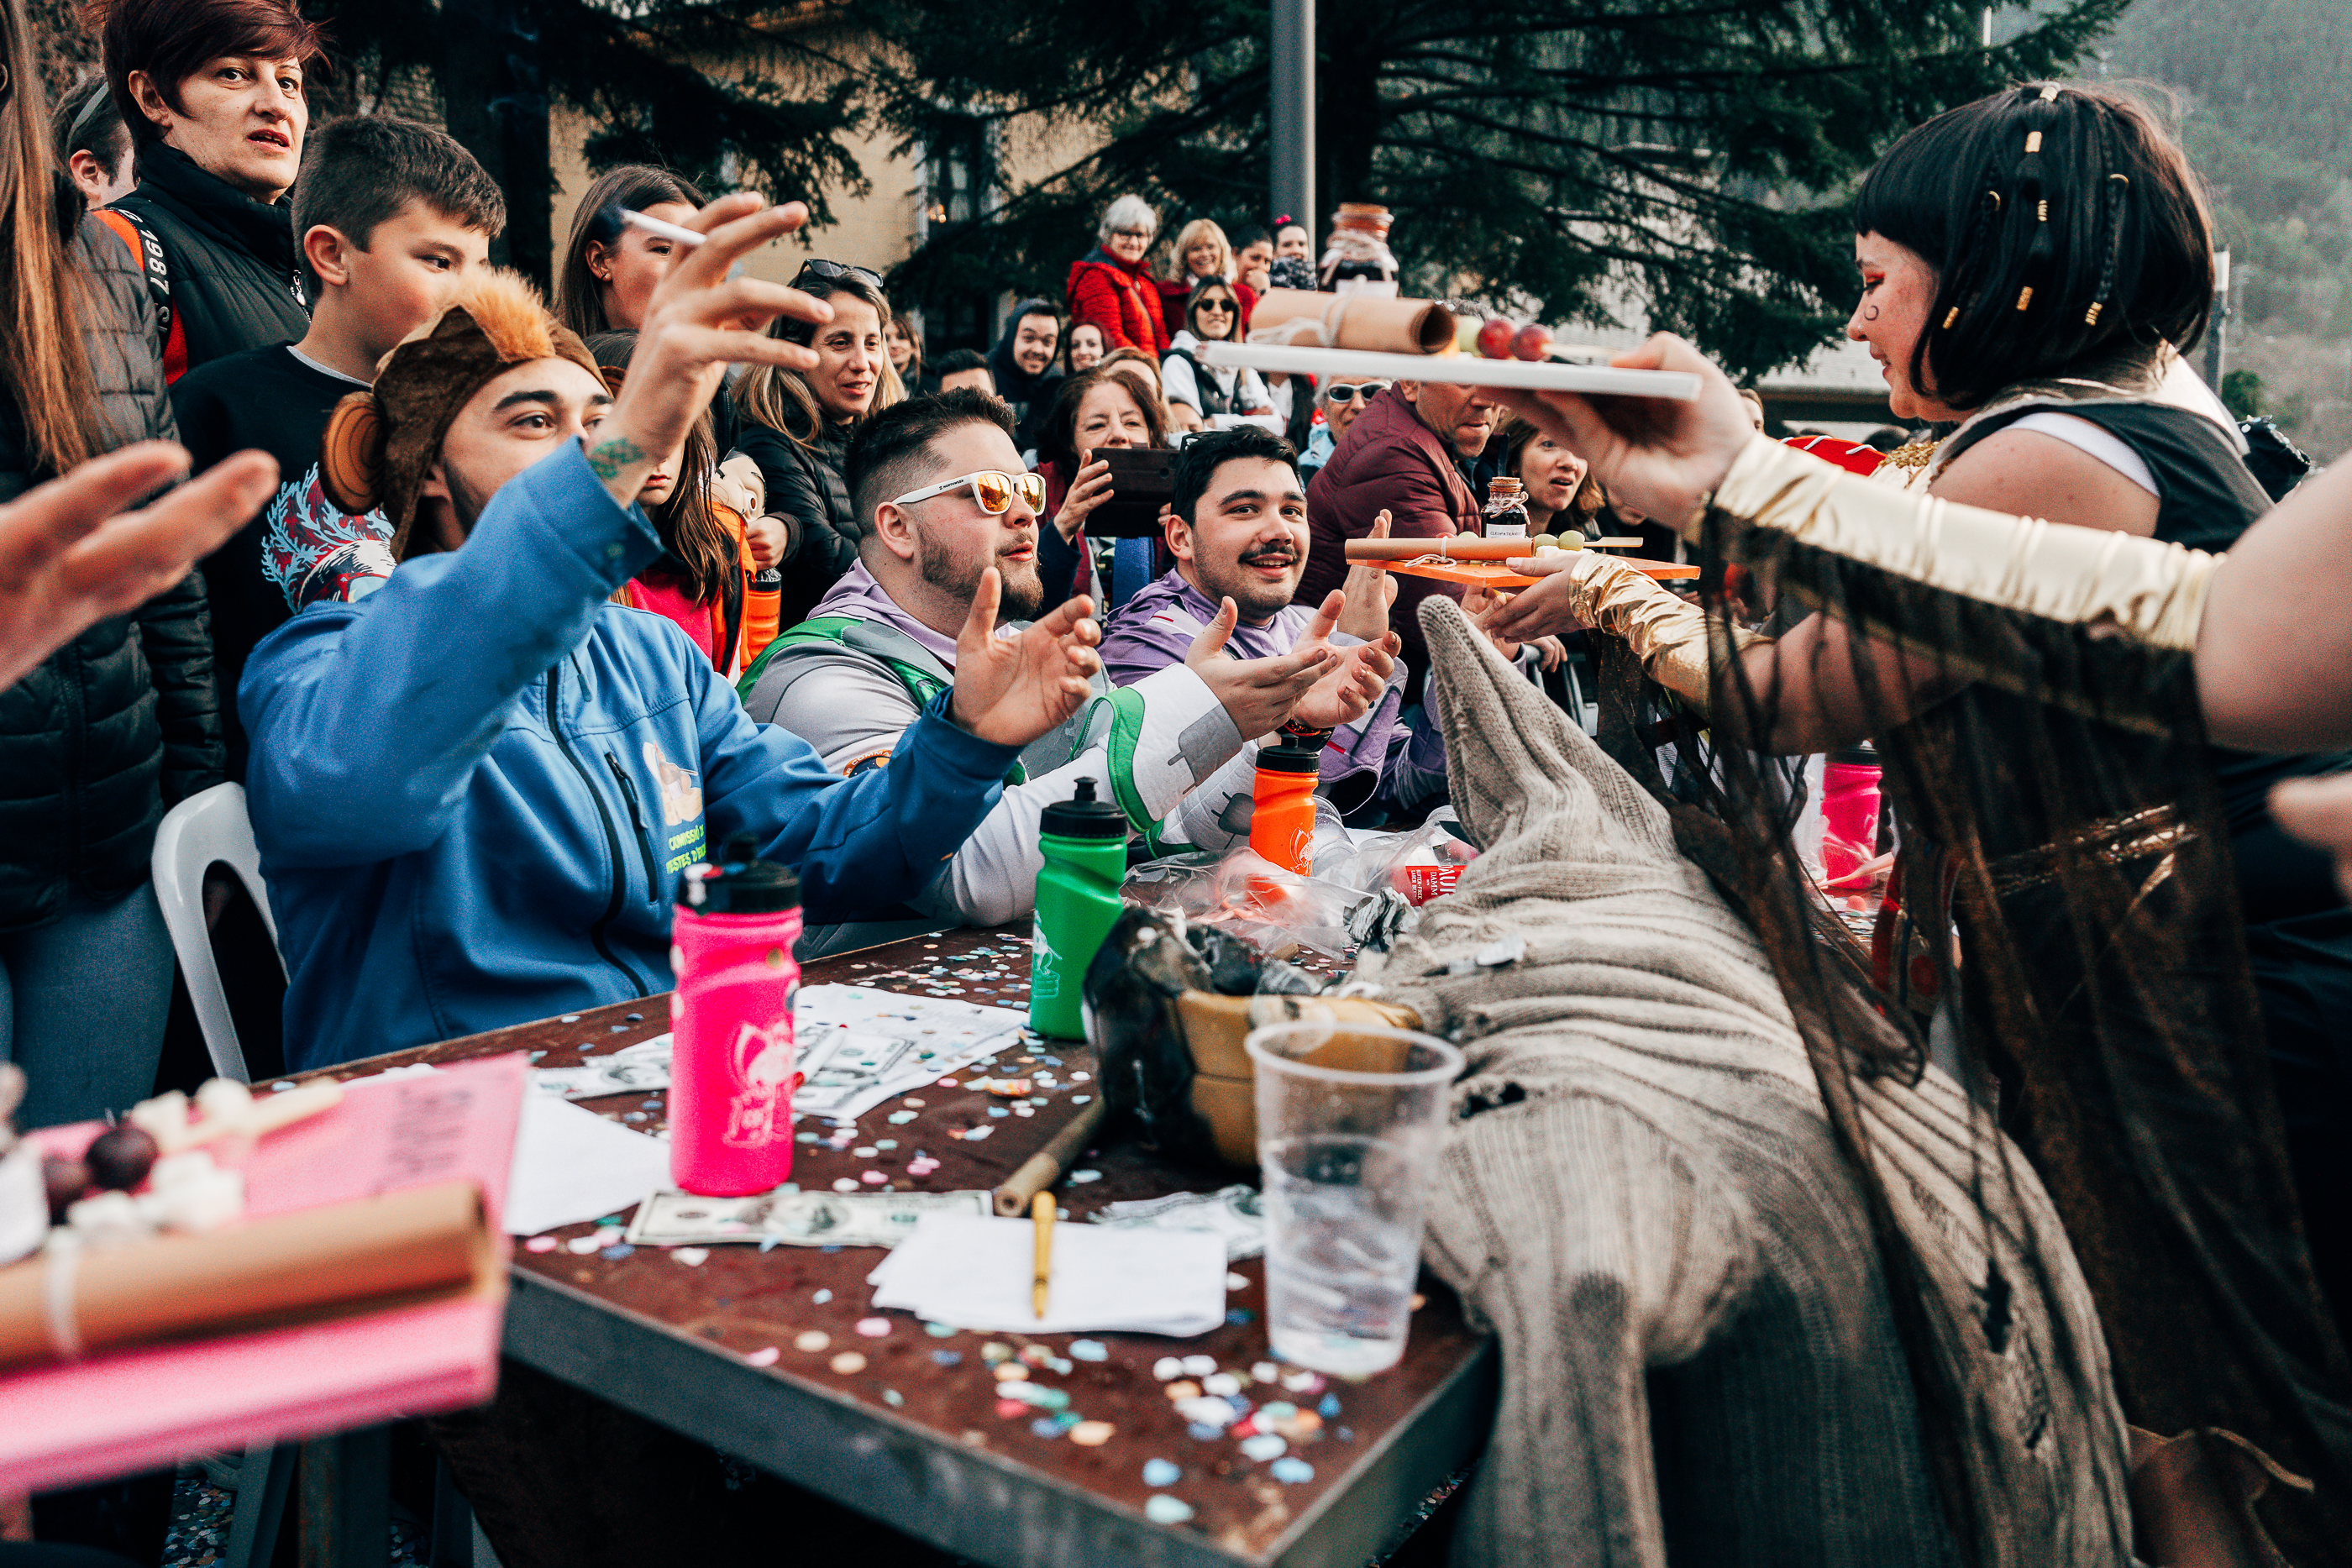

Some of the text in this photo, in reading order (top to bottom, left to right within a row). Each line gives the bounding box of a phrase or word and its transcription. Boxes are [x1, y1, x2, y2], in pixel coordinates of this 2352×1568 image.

[140, 229, 170, 296] 1987
[851, 750, 890, 766] COMMA
[665, 852, 692, 874] FESTES
[1430, 872, 1438, 896] DAMM
